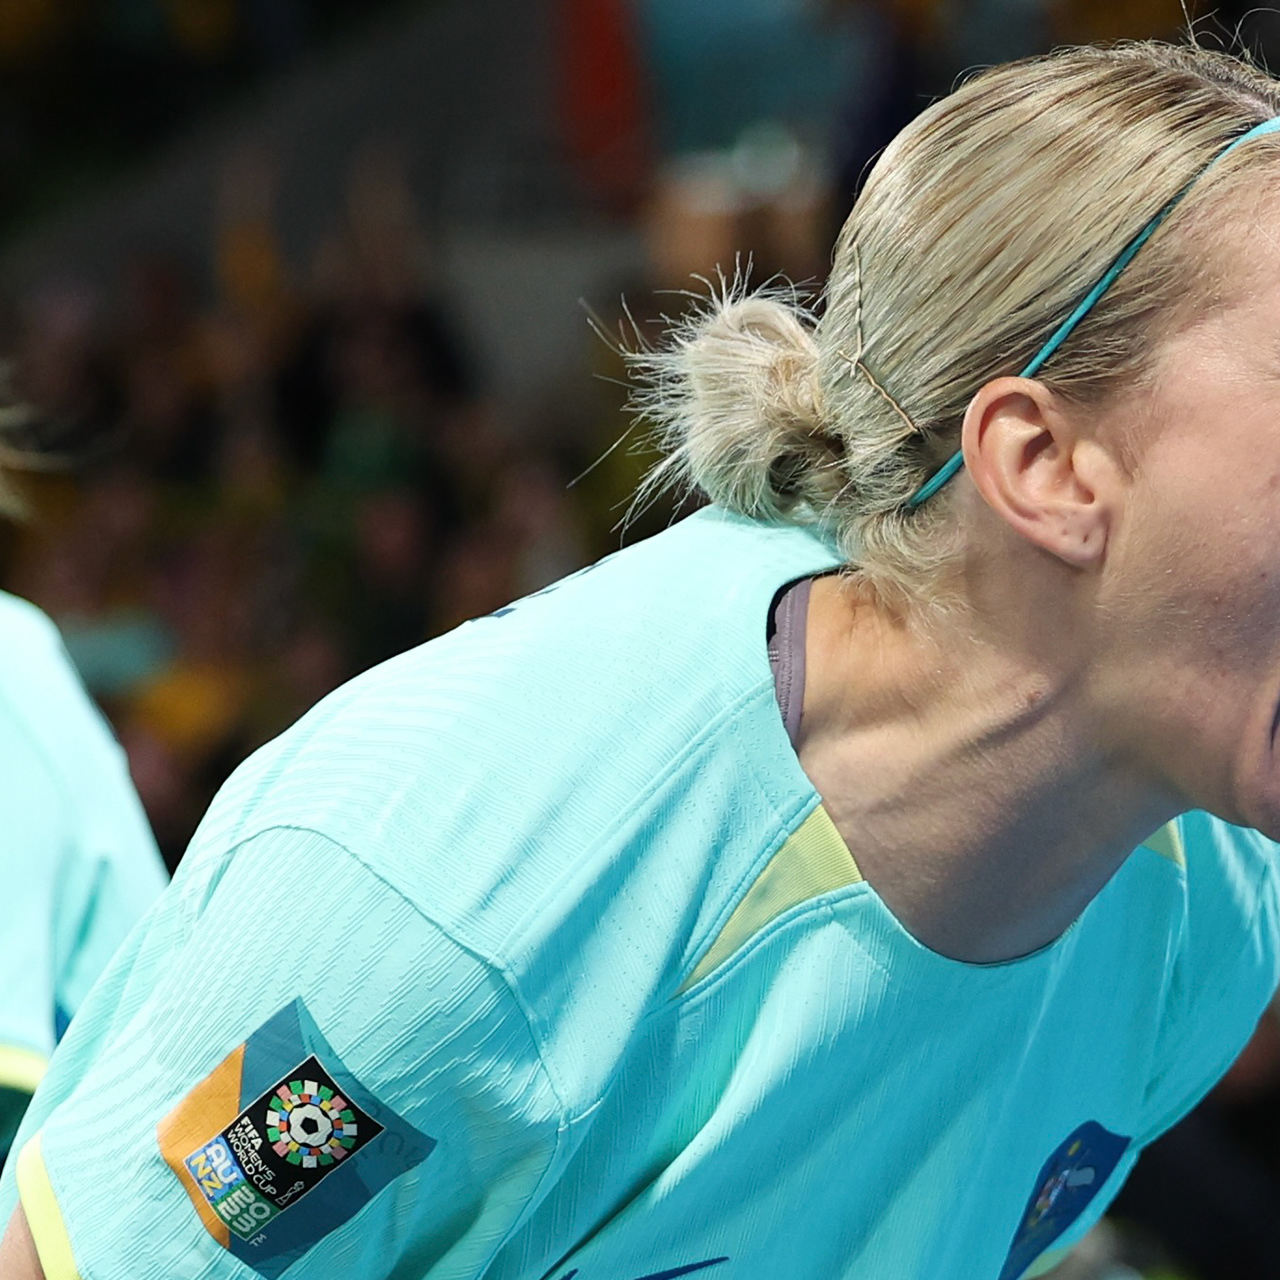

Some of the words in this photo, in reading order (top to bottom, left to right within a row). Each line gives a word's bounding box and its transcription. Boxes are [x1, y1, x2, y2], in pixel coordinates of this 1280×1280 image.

[234, 1123, 276, 1182] WOMEN'S
[240, 1116, 263, 1151] FIFA
[190, 1153, 223, 1197] NZ
[206, 1143, 238, 1184] AU
[227, 1129, 255, 1175] WORLD
[252, 1174, 277, 1195] CUP
[231, 1185, 271, 1219] 20
[249, 1233, 267, 1247] TM
